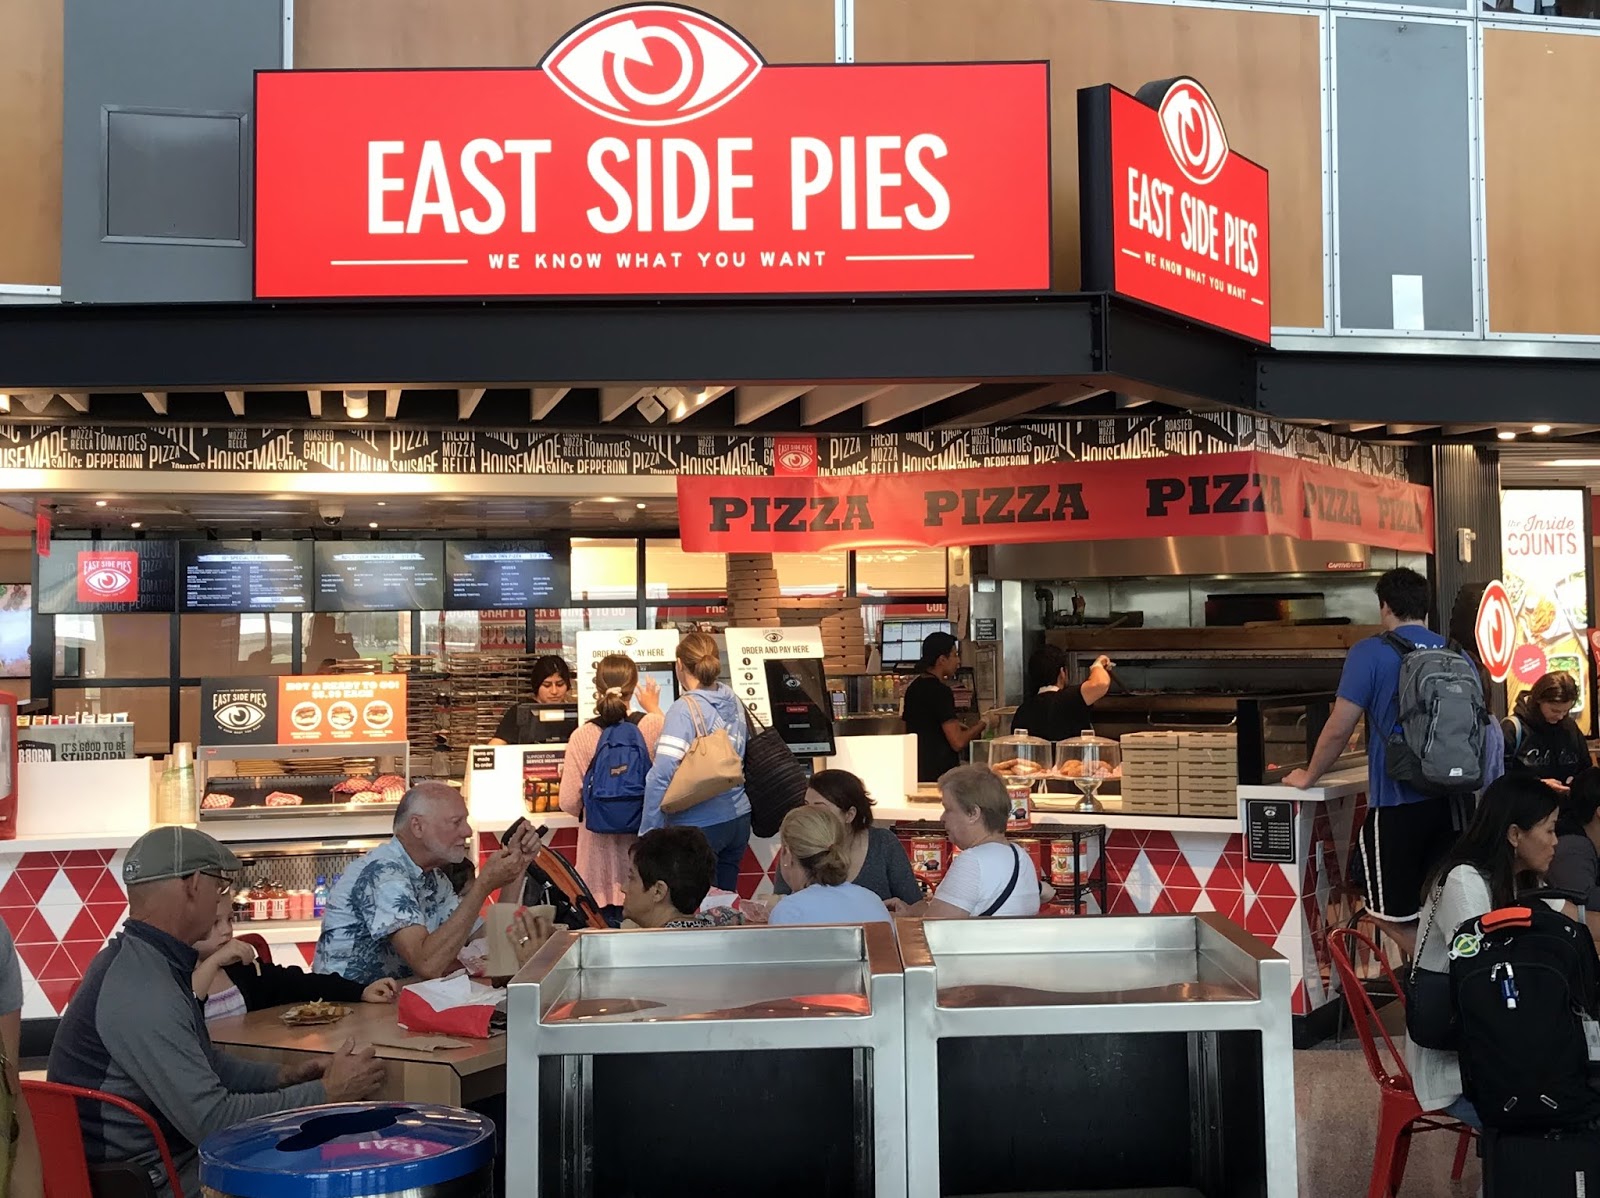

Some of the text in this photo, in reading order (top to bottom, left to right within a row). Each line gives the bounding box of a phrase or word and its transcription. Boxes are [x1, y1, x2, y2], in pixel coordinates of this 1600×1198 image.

[368, 133, 951, 235] EAST SIDE PIES
[1128, 167, 1258, 277] EAST SIDE PIES
[488, 251, 826, 269] WE KNOW WHAT YOU WANT
[1144, 251, 1246, 300] WE KNOW WHAT YOU WANT
[70, 429, 94, 440] MOZZA
[303, 430, 334, 441] ROASTED
[1165, 419, 1192, 431] ROASTED
[70, 439, 94, 450] RELLA
[94, 431, 147, 451] TOMATOES
[207, 429, 294, 469] HOUSEMADE
[390, 429, 429, 462] PIZZA
[442, 441, 476, 457] MOZZA
[584, 439, 631, 457] TOMATOES
[802, 444, 814, 455] PIES
[902, 430, 970, 473] HOUSEMADE
[990, 434, 1032, 454] TOMATOES
[1165, 430, 1202, 455] GARLIC
[149, 445, 181, 469] PIZZA
[303, 441, 345, 471] GARLIC
[480, 432, 562, 474] HOUSEMADE
[633, 451, 661, 474] PIZZA
[680, 434, 758, 475] HOUSEMADE
[830, 437, 861, 470] PIZZA
[871, 447, 898, 462] MOZZA
[1034, 444, 1060, 465] PIZZA
[442, 457, 476, 473] RELLA
[923, 483, 1089, 527] PIZZA
[1146, 473, 1283, 517] PIZZA
[1303, 481, 1362, 526] PIZZA
[709, 495, 875, 532] PIZZA
[1523, 514, 1575, 532] Inside
[1508, 532, 1577, 555] COUNTS
[83, 560, 132, 576] EAST SIDE PIES
[646, 648, 664, 656] HERE
[741, 645, 809, 655] ORDER AND PAY HERE
[213, 693, 267, 710] EAST SIDE PIES
[61, 741, 126, 752] IT'S GOOD TO BE
